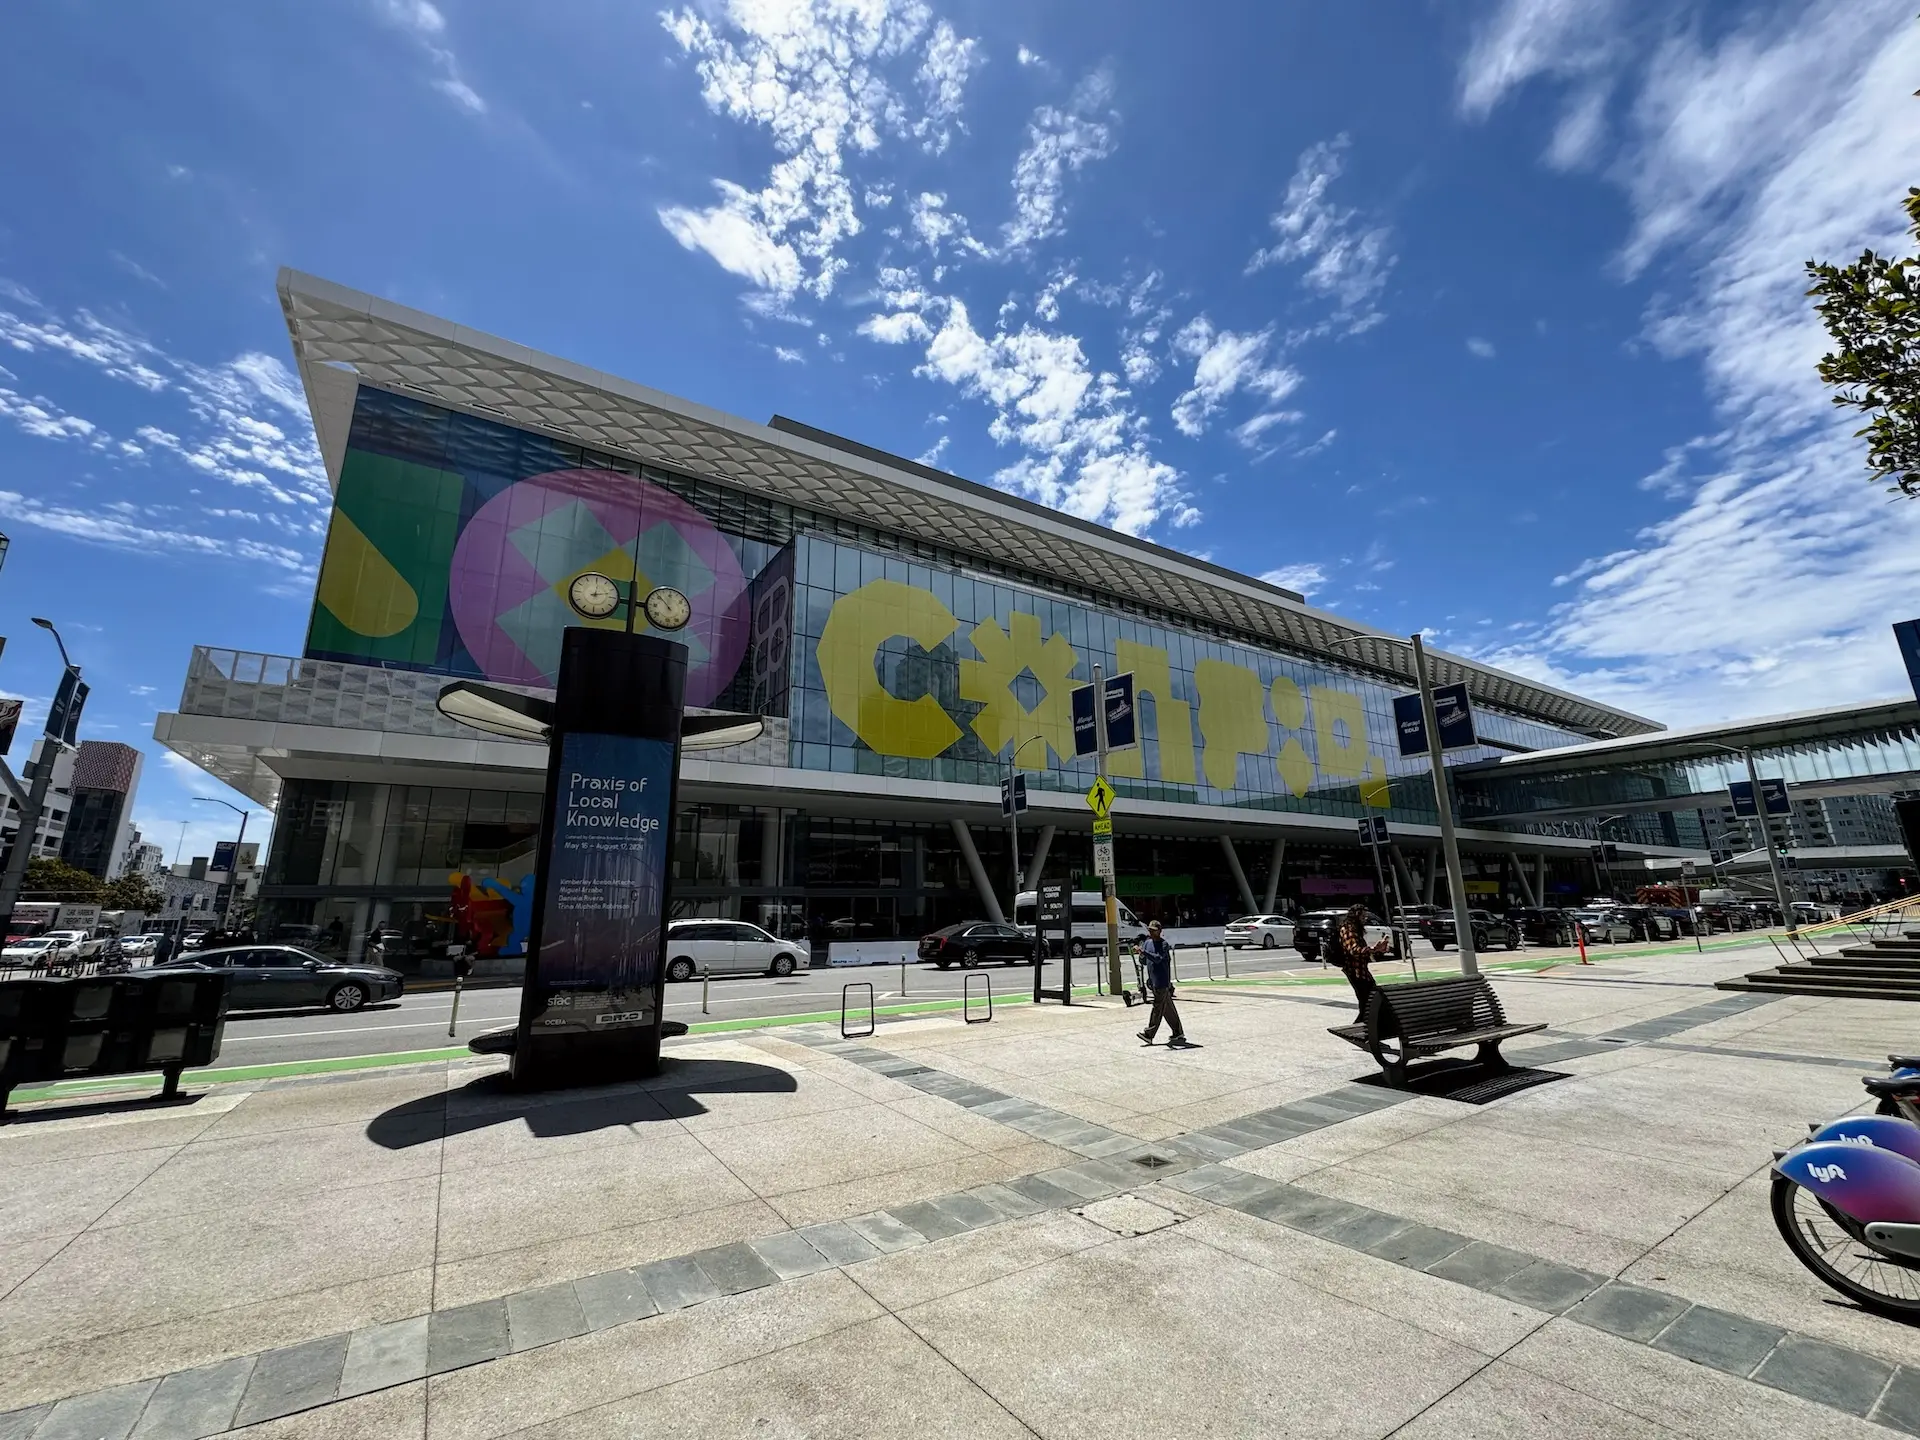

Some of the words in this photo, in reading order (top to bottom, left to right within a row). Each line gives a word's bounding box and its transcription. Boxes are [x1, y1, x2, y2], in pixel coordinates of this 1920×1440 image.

[1075, 721, 1096, 733] DYNAMIC
[1403, 726, 1420, 734] BOLD
[570, 772, 626, 791] Praxis
[629, 777, 648, 793] of
[568, 791, 619, 809] Local
[566, 809, 660, 833] Knowledge
[1094, 822, 1110, 830] AHEAD
[564, 842, 580, 850] May
[596, 842, 619, 851] August
[547, 994, 572, 1006] sfac
[1806, 1162, 1848, 1183] lyft
